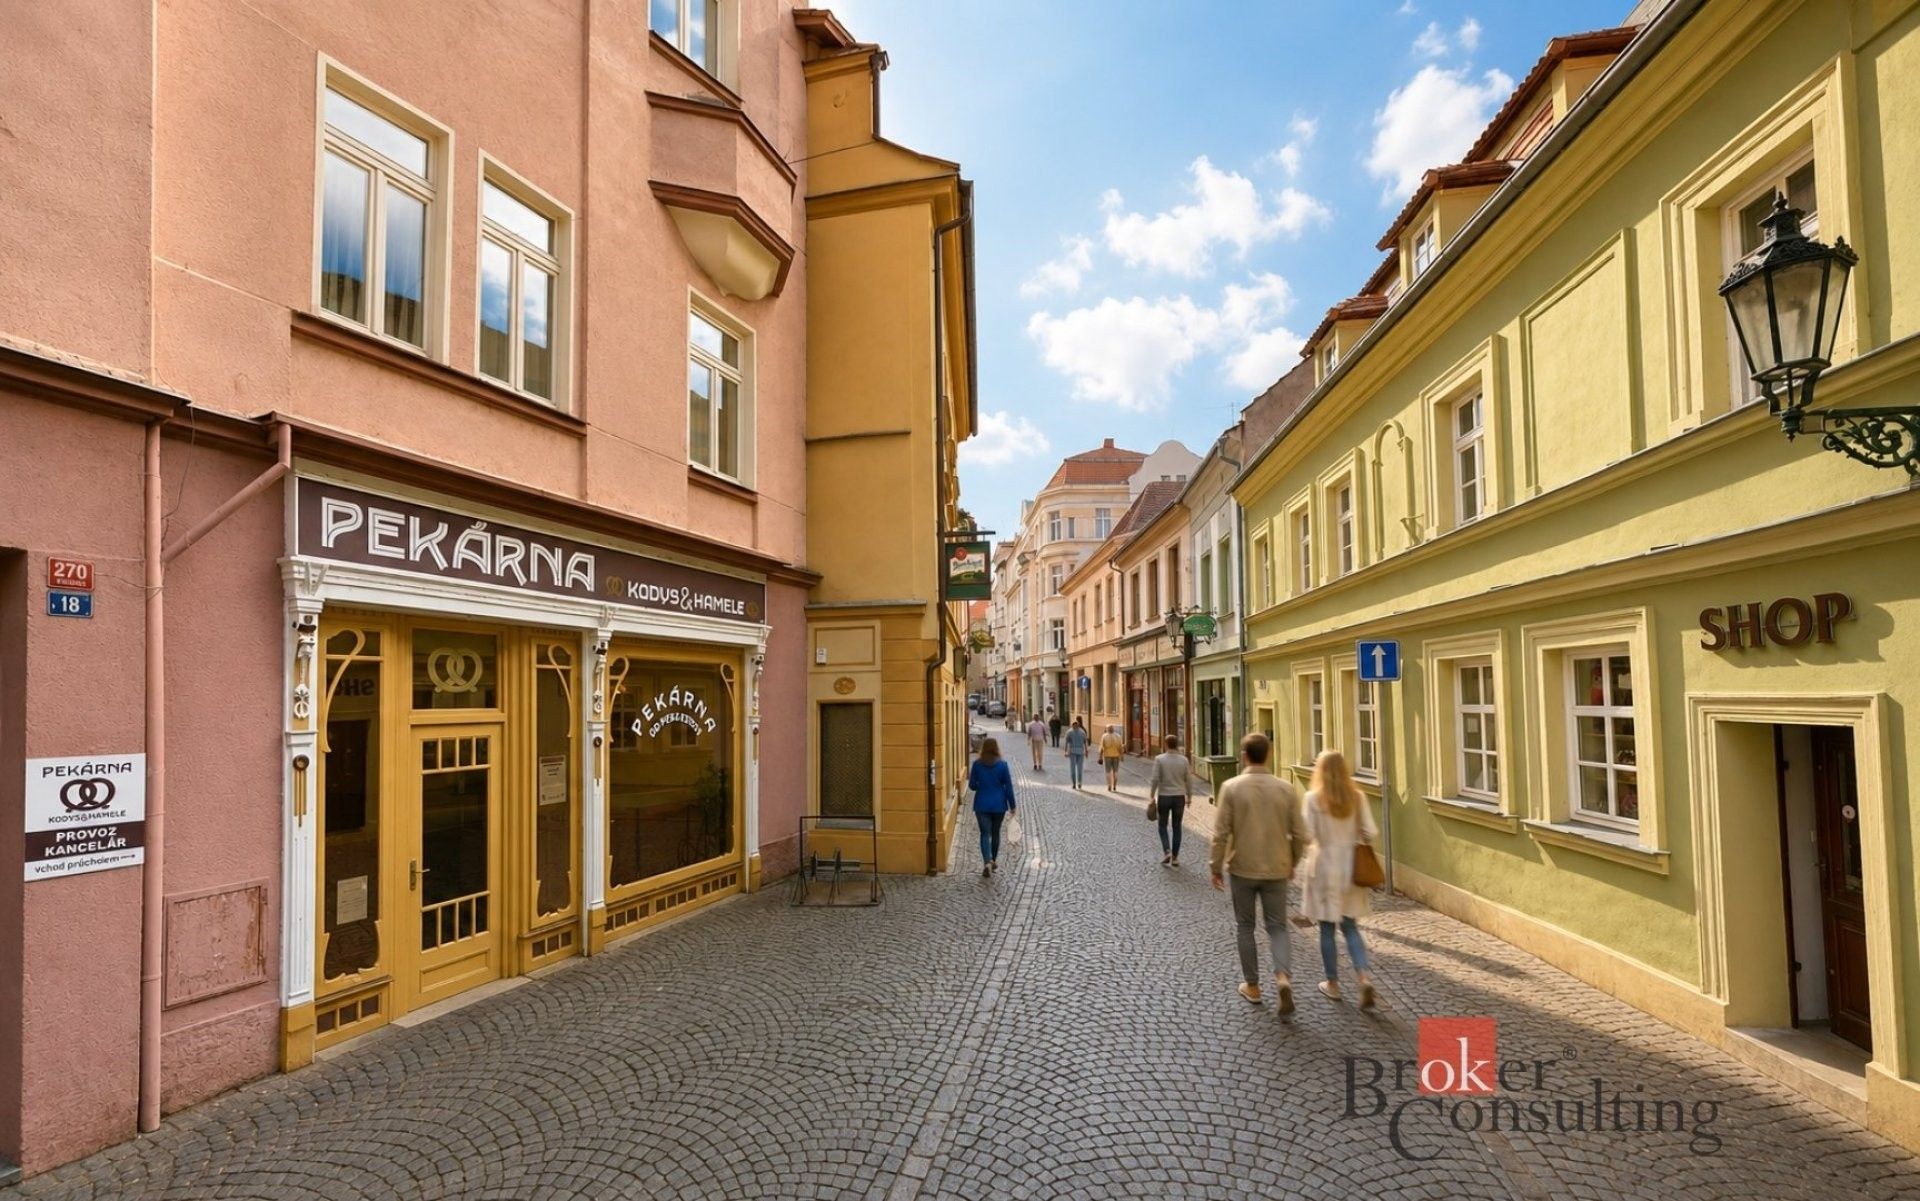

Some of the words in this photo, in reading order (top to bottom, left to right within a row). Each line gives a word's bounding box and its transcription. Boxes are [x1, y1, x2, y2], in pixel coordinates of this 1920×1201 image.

[321, 496, 596, 592] PEKÁRNA
[54, 562, 87, 580] 270
[61, 595, 80, 613] 18
[1699, 592, 1853, 652] SHOP
[631, 684, 717, 737] PEKÁRNA
[42, 762, 132, 778] PEKÁRNA
[56, 826, 117, 842] PROVOZ
[35, 862, 65, 873] vchod
